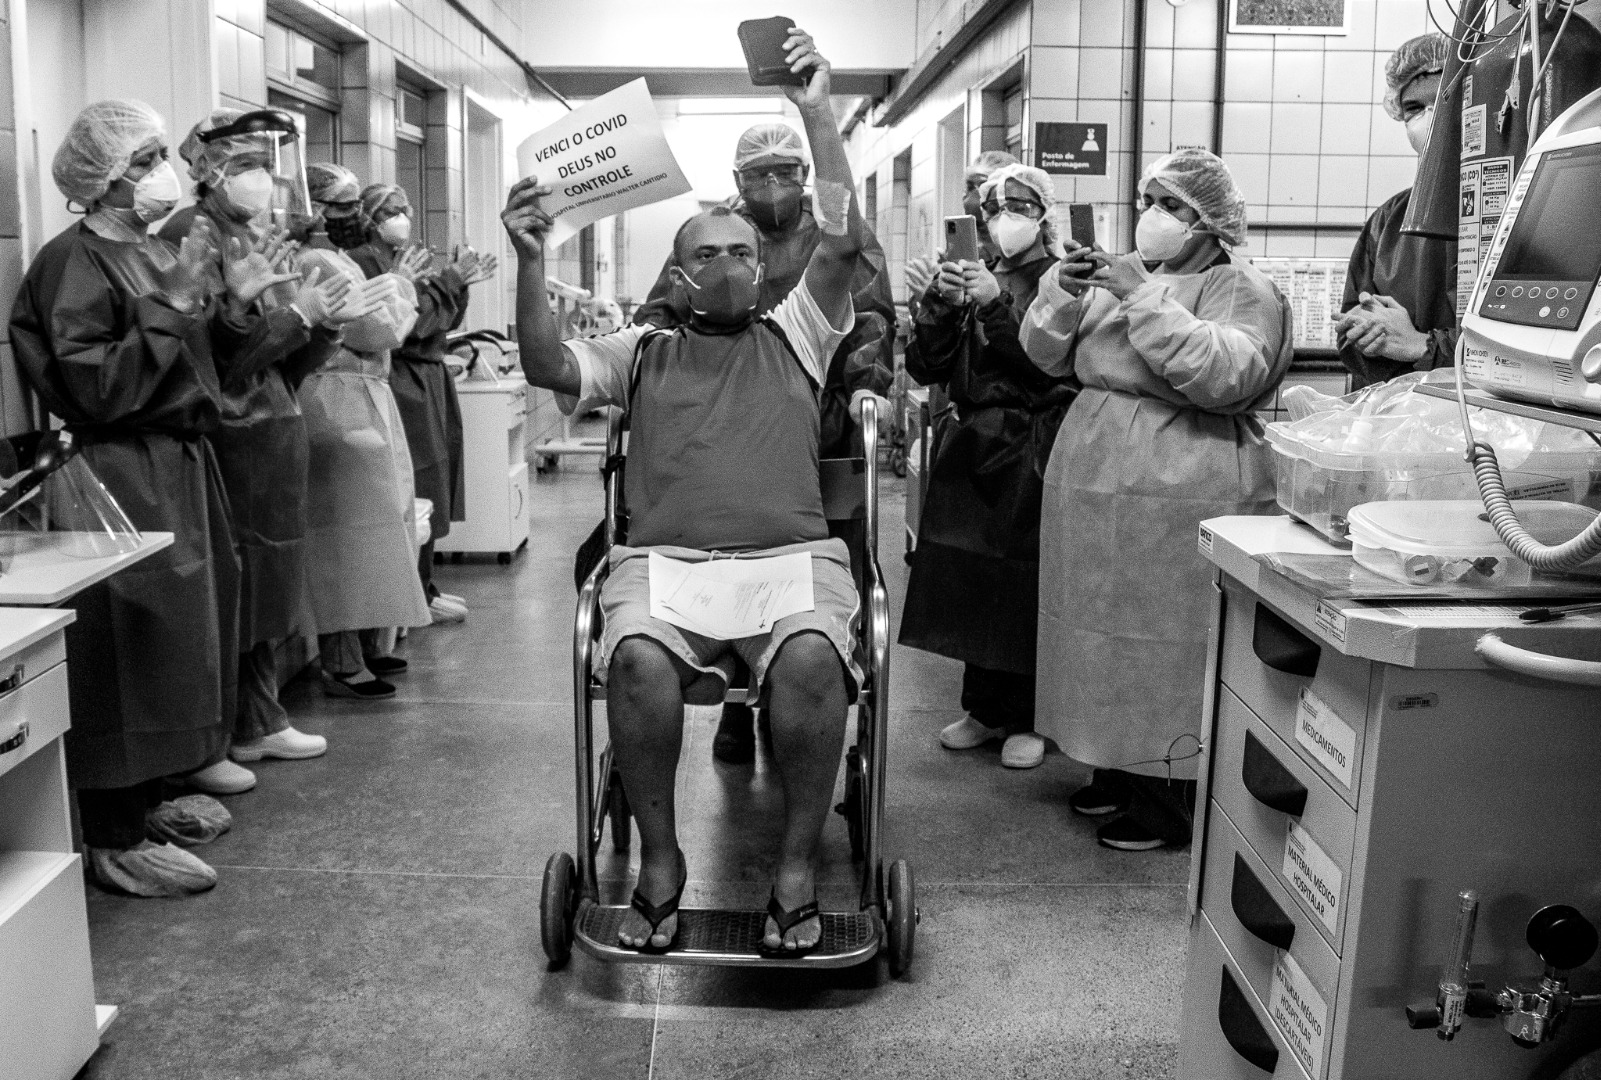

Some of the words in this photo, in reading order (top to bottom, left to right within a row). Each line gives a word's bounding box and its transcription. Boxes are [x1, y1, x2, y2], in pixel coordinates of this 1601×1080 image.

[535, 137, 570, 163] VENCI
[572, 132, 583, 146] O
[586, 113, 628, 140] COVID
[1041, 151, 1064, 160] Posto
[1064, 151, 1075, 160] de
[557, 155, 593, 179] DEUS
[594, 145, 617, 164] NO
[563, 164, 633, 198] CONTROLE
[1041, 160, 1090, 169] Enfermagem
[616, 183, 640, 198] WALTER
[1302, 719, 1346, 768] MEDICAMENTOS
[1288, 845, 1313, 882] MATERIAL
[1313, 874, 1336, 908] MÉDICO
[1293, 872, 1325, 918] HOSPITALAR
[1276, 965, 1300, 1007] MATERIAL
[1300, 1000, 1322, 1037] MÉDICO
[1281, 994, 1312, 1045] HOSPITALAR
